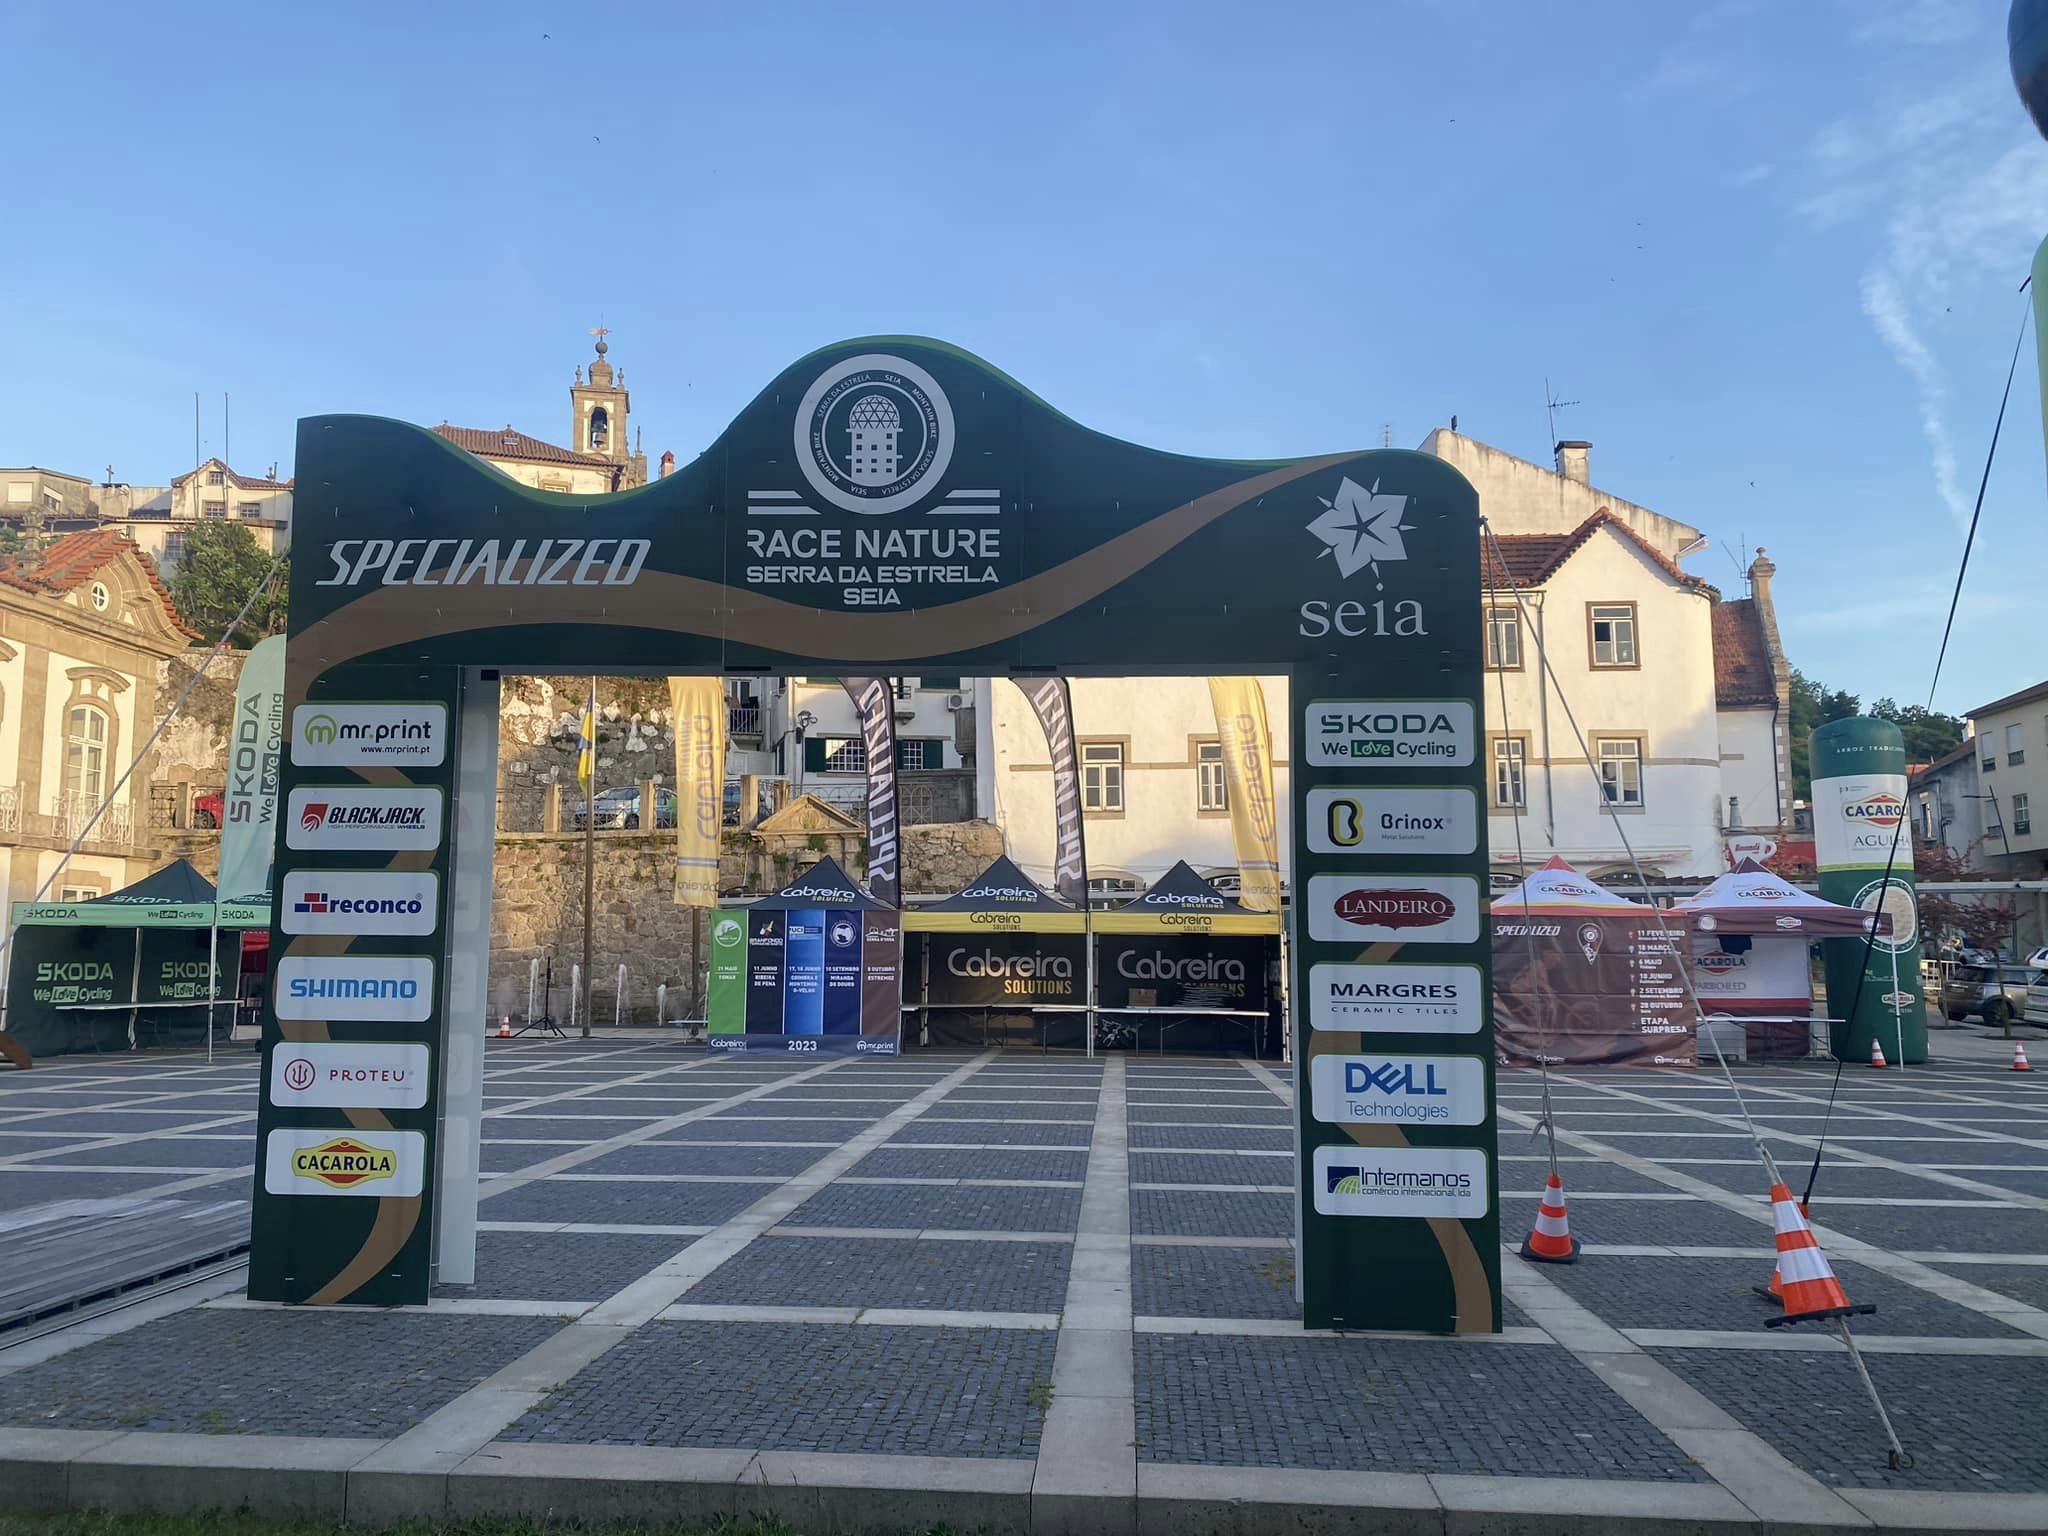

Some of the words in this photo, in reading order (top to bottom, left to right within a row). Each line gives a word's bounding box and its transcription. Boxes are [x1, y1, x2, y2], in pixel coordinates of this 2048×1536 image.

[883, 375, 901, 386] SEIA
[747, 529, 841, 558] RACE
[855, 529, 1000, 558] NATURE
[315, 539, 651, 585] SPECIALIZED
[746, 566, 834, 583] SERRA
[839, 566, 873, 583] DA
[877, 566, 1000, 583] ESTRELA
[843, 588, 901, 605] SEIA
[1300, 582, 1429, 637] seia
[267, 693, 283, 751] Cycling
[340, 719, 432, 743] mr.print
[361, 745, 430, 756] www.mrprint.pt
[1321, 742, 1348, 755] We
[1353, 741, 1391, 756] Love
[1396, 742, 1456, 757] Cycling
[263, 756, 279, 796] Love
[259, 798, 274, 824] We
[328, 807, 425, 824] BLACKJACK
[1381, 813, 1444, 830] Brinox
[780, 886, 855, 899] Cabreira
[961, 886, 1038, 900] Cabreira
[1145, 893, 1224, 905] Cabreira
[329, 898, 422, 914] reconco
[1343, 899, 1447, 914] LANDEIRO
[969, 912, 1021, 924] Cabreira
[1159, 913, 1212, 925] Cabreira
[948, 947, 1073, 978] Cabreira
[1117, 950, 1245, 981] Cabreira
[33, 989, 51, 1001] We
[79, 987, 113, 1001] Cycling
[160, 984, 174, 996] We
[290, 978, 417, 998] SHIMANO
[1004, 979, 1073, 995] SOLUTIONS
[1330, 983, 1457, 998] MARGRES
[1331, 1006, 1404, 1014] CERAMIC
[788, 1040, 818, 1051] 2023
[329, 1069, 405, 1082] PROTEU
[1345, 1062, 1447, 1095] DELL
[1346, 1100, 1449, 1121] Technologies
[1361, 1167, 1471, 1187] Intermanos
[1458, 1189, 1471, 1197] lda
